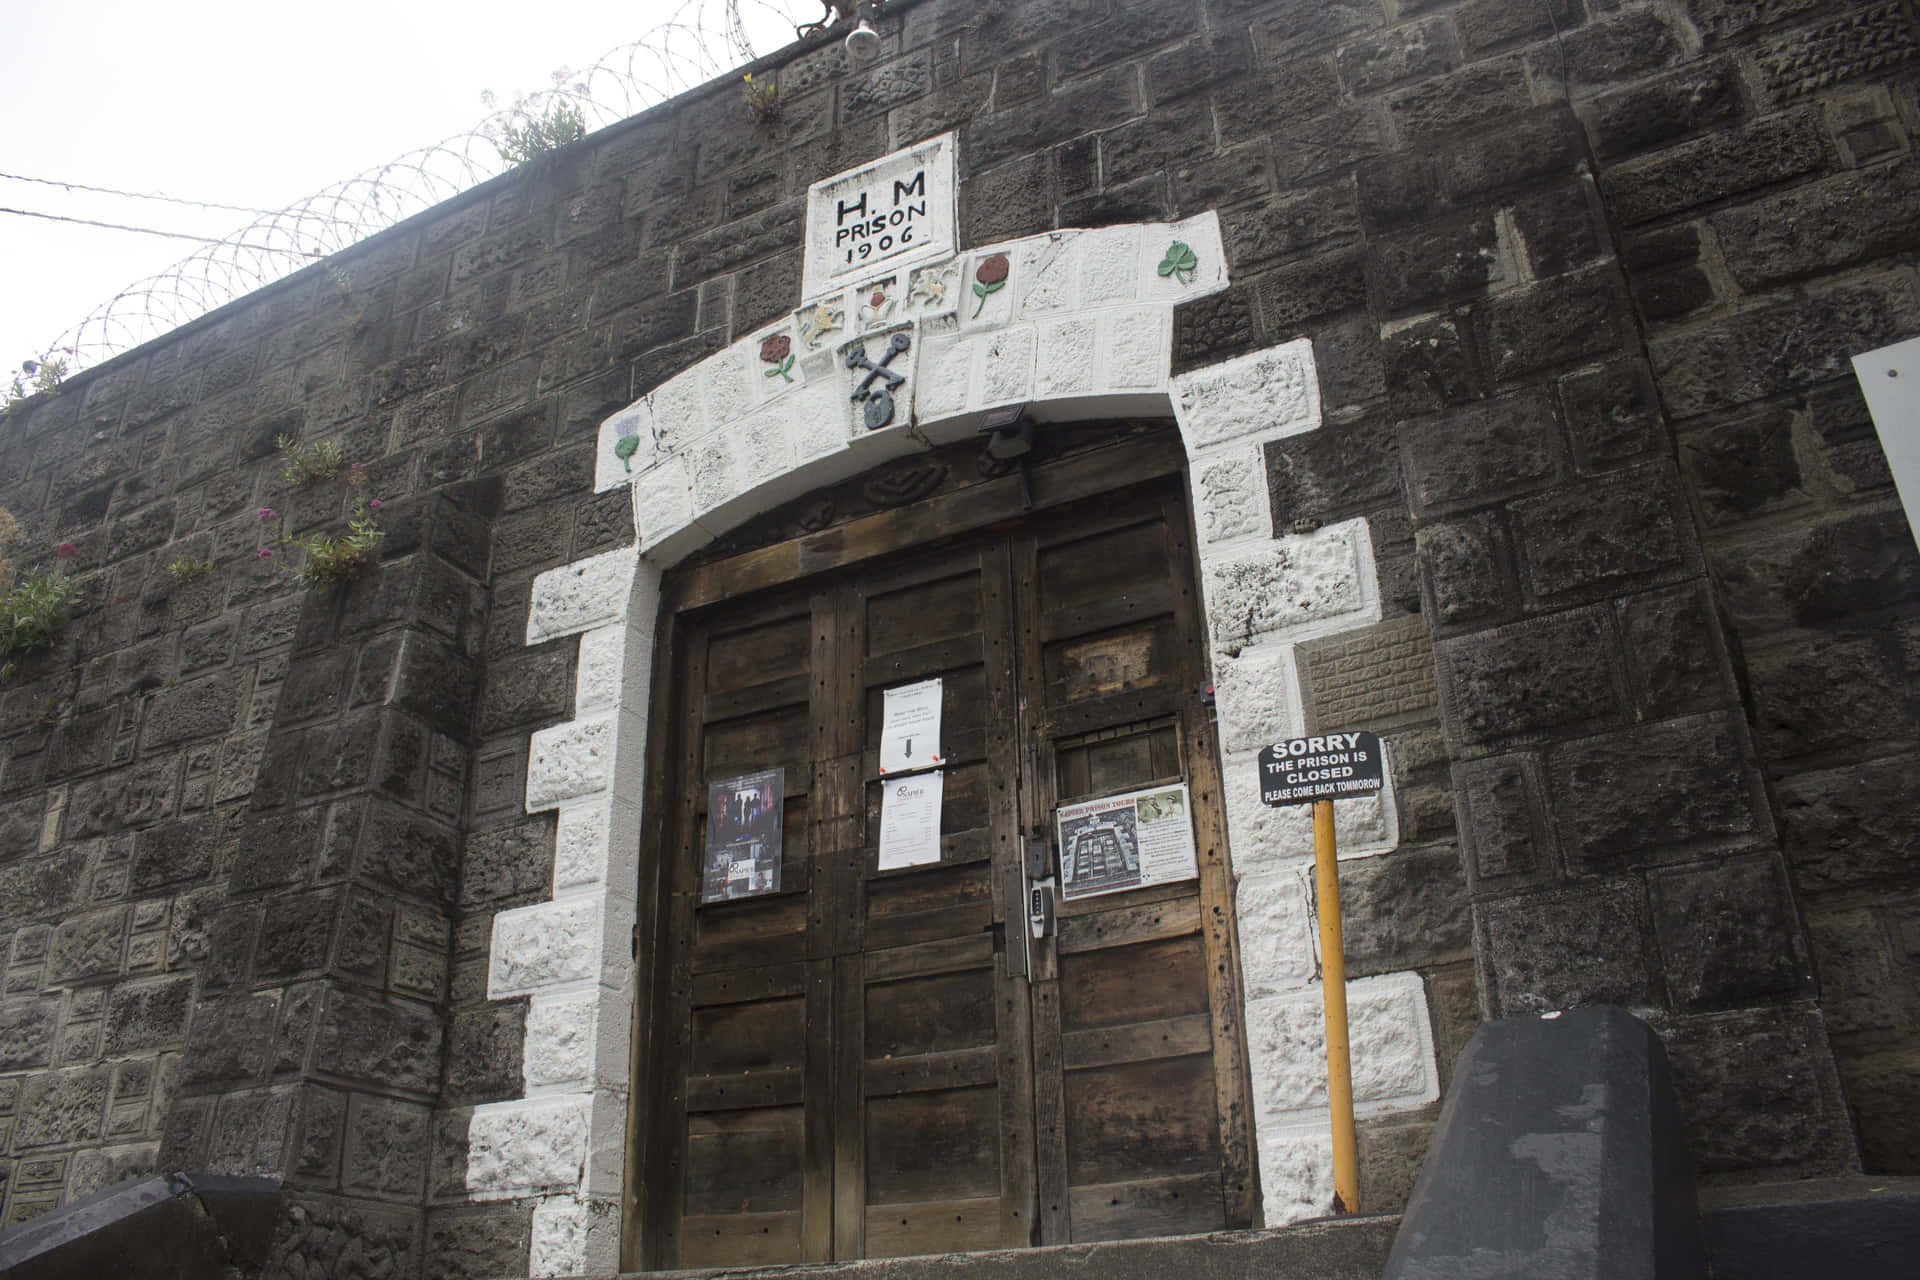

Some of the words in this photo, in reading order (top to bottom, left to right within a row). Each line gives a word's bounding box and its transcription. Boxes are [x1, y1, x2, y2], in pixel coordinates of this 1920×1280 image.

[894, 171, 925, 206] M
[836, 200, 926, 248] PRISON
[846, 226, 913, 263] 1906
[1272, 732, 1361, 759] SORRY
[1266, 760, 1294, 774] THE
[1297, 752, 1349, 769] PRISON
[1353, 751, 1367, 762] IS
[1286, 766, 1353, 784] CLOSED
[1265, 789, 1292, 802] PLEASE
[1292, 785, 1314, 798] COME
[1315, 782, 1335, 795] BACK
[1336, 778, 1380, 792] TOMMOROW
